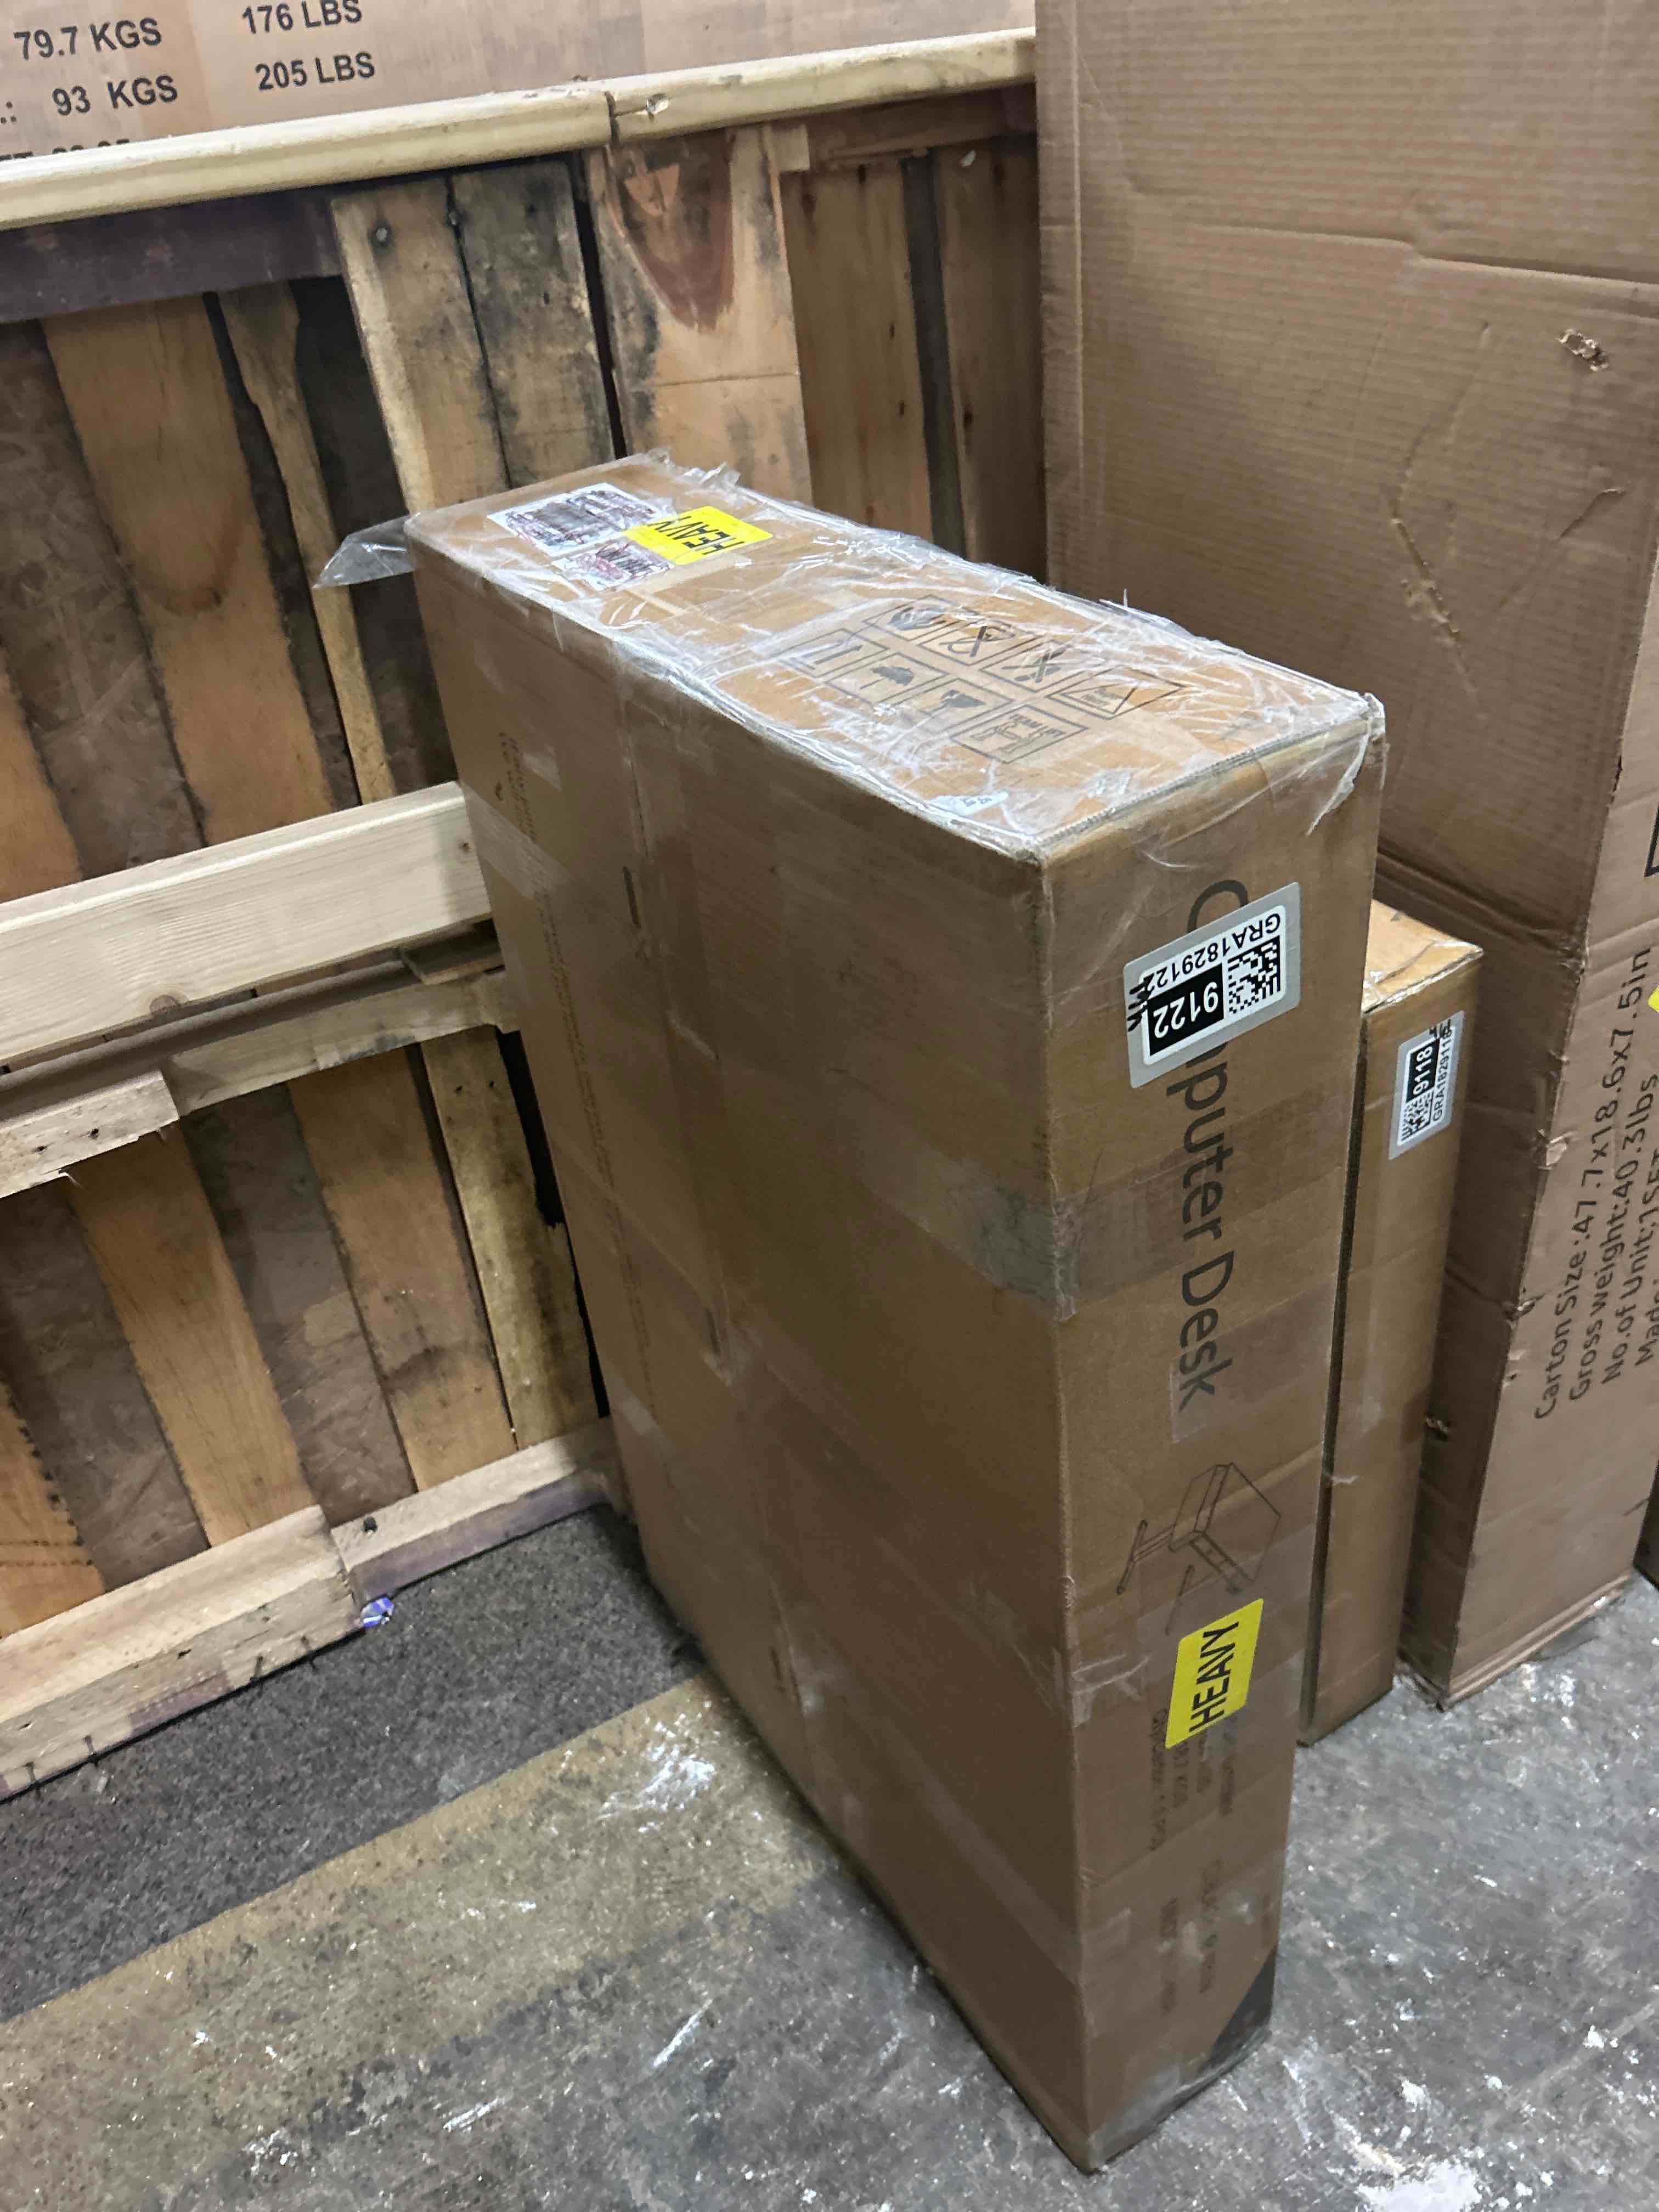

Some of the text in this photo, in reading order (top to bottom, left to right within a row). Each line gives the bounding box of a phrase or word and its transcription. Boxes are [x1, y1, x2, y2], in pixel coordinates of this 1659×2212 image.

[14, 17, 162, 60] 79.7 KGS
[241, 0, 363, 34] 176 LBS
[52, 87, 91, 116] 93
[108, 75, 178, 109] KGS
[255, 51, 375, 91] 205 LBS
[647, 516, 745, 555] HEAVY
[1153, 981, 1219, 1039] 9122
[1413, 1045, 1434, 1096] 9118
[1166, 879, 1249, 1413] Cputer Desk
[1534, 1318, 1572, 1419] Carton
[1555, 1251, 1587, 1317] Size
[1565, 1318, 1603, 1401] Gross
[1601, 1304, 1637, 1384] No.of
[1188, 1621, 1239, 1734] HEAVY
